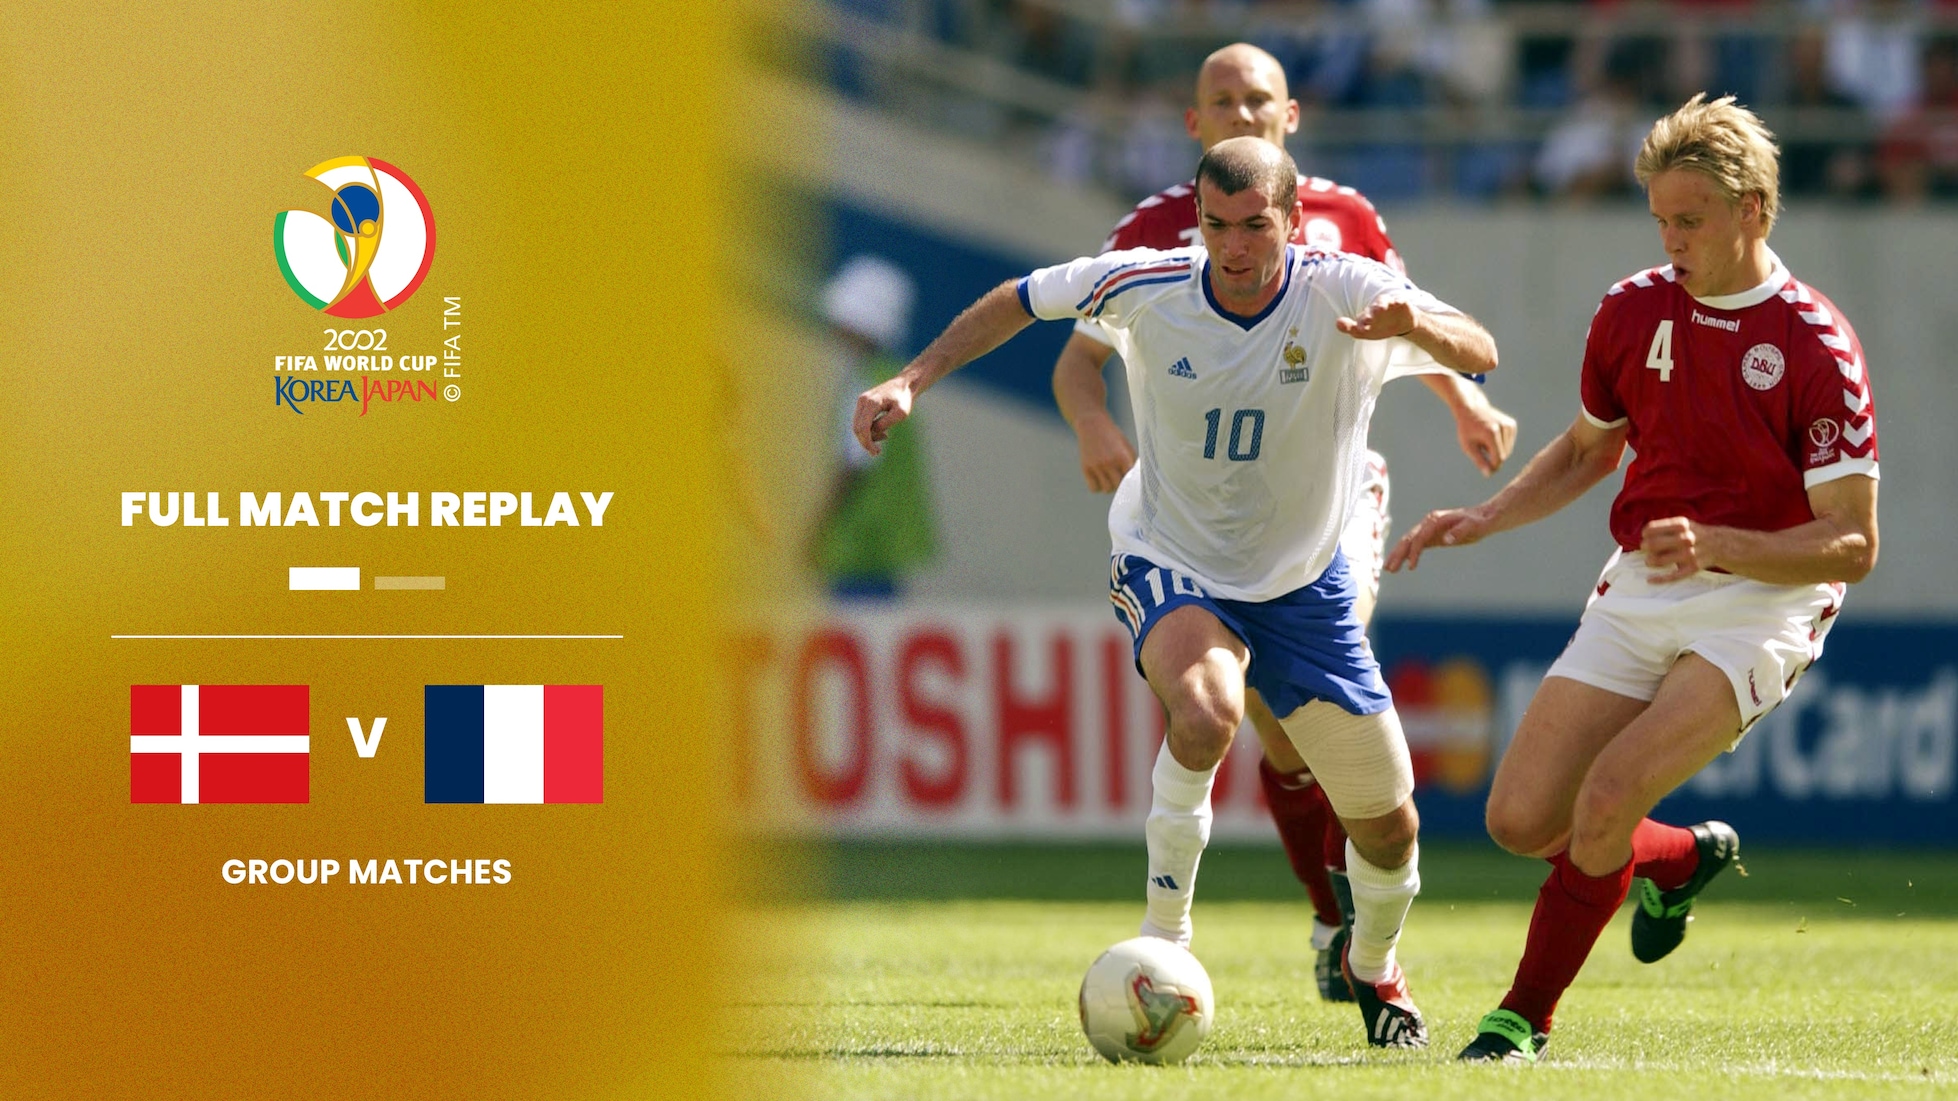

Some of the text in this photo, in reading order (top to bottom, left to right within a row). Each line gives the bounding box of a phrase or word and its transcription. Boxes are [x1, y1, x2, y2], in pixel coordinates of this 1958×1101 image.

[1691, 309, 1740, 333] hummel
[1646, 319, 1675, 382] 4
[1750, 356, 1776, 376] DBU
[1168, 364, 1197, 380] adidas
[1203, 407, 1266, 462] 10
[716, 626, 1270, 812] TOSHI
